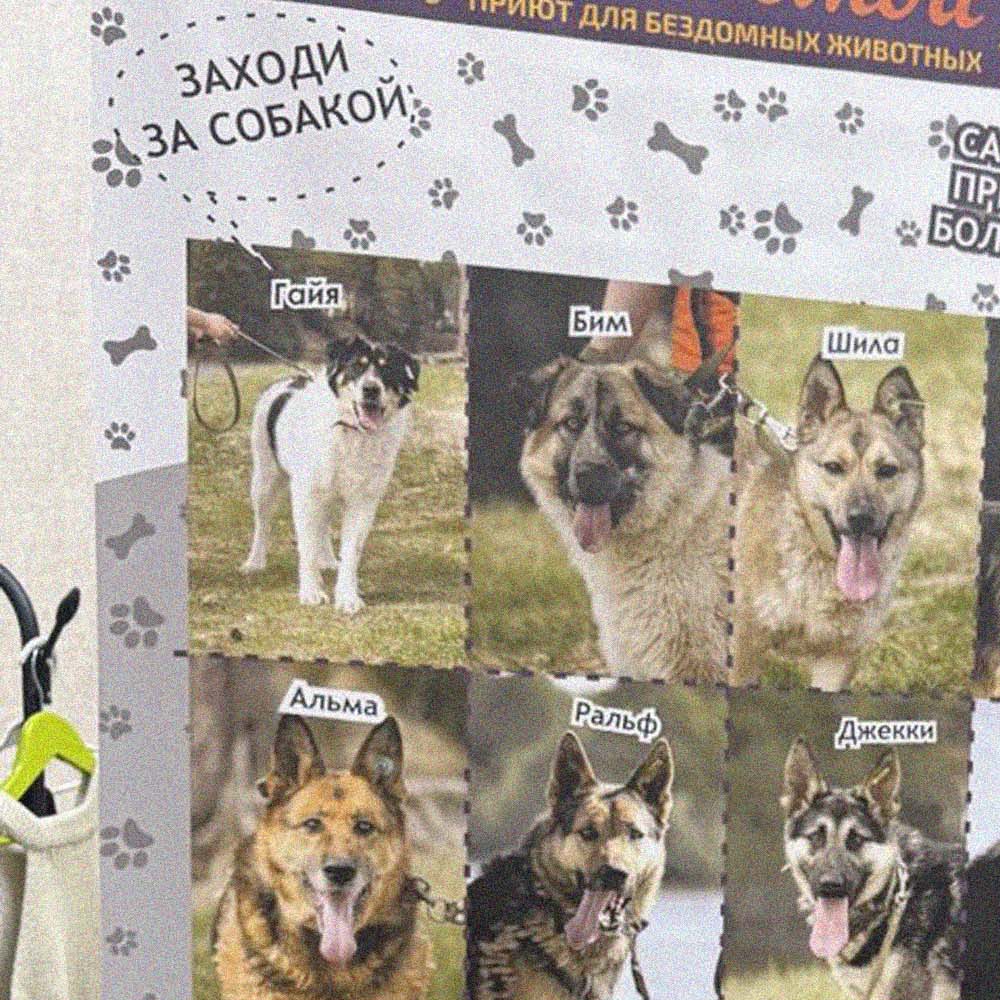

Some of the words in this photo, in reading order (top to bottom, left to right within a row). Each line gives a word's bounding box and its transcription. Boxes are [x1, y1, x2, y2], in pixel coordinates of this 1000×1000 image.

[469, 0, 573, 23] ПРИЮТ
[579, 3, 637, 31] ДЛЯ
[645, 12, 821, 54] БЕЗДОМНЫХ
[828, 34, 983, 73] ЖИВОТНЫХ
[175, 39, 349, 98] ЗАХОДИ
[142, 119, 199, 157] ЗА
[209, 76, 407, 146] СОБАКОЙ
[273, 279, 340, 306] Гайя
[573, 309, 628, 334] Бим
[827, 331, 900, 356] Шила
[288, 687, 379, 717] Альма
[574, 700, 661, 738] Ральф
[837, 719, 935, 745] Джекки
